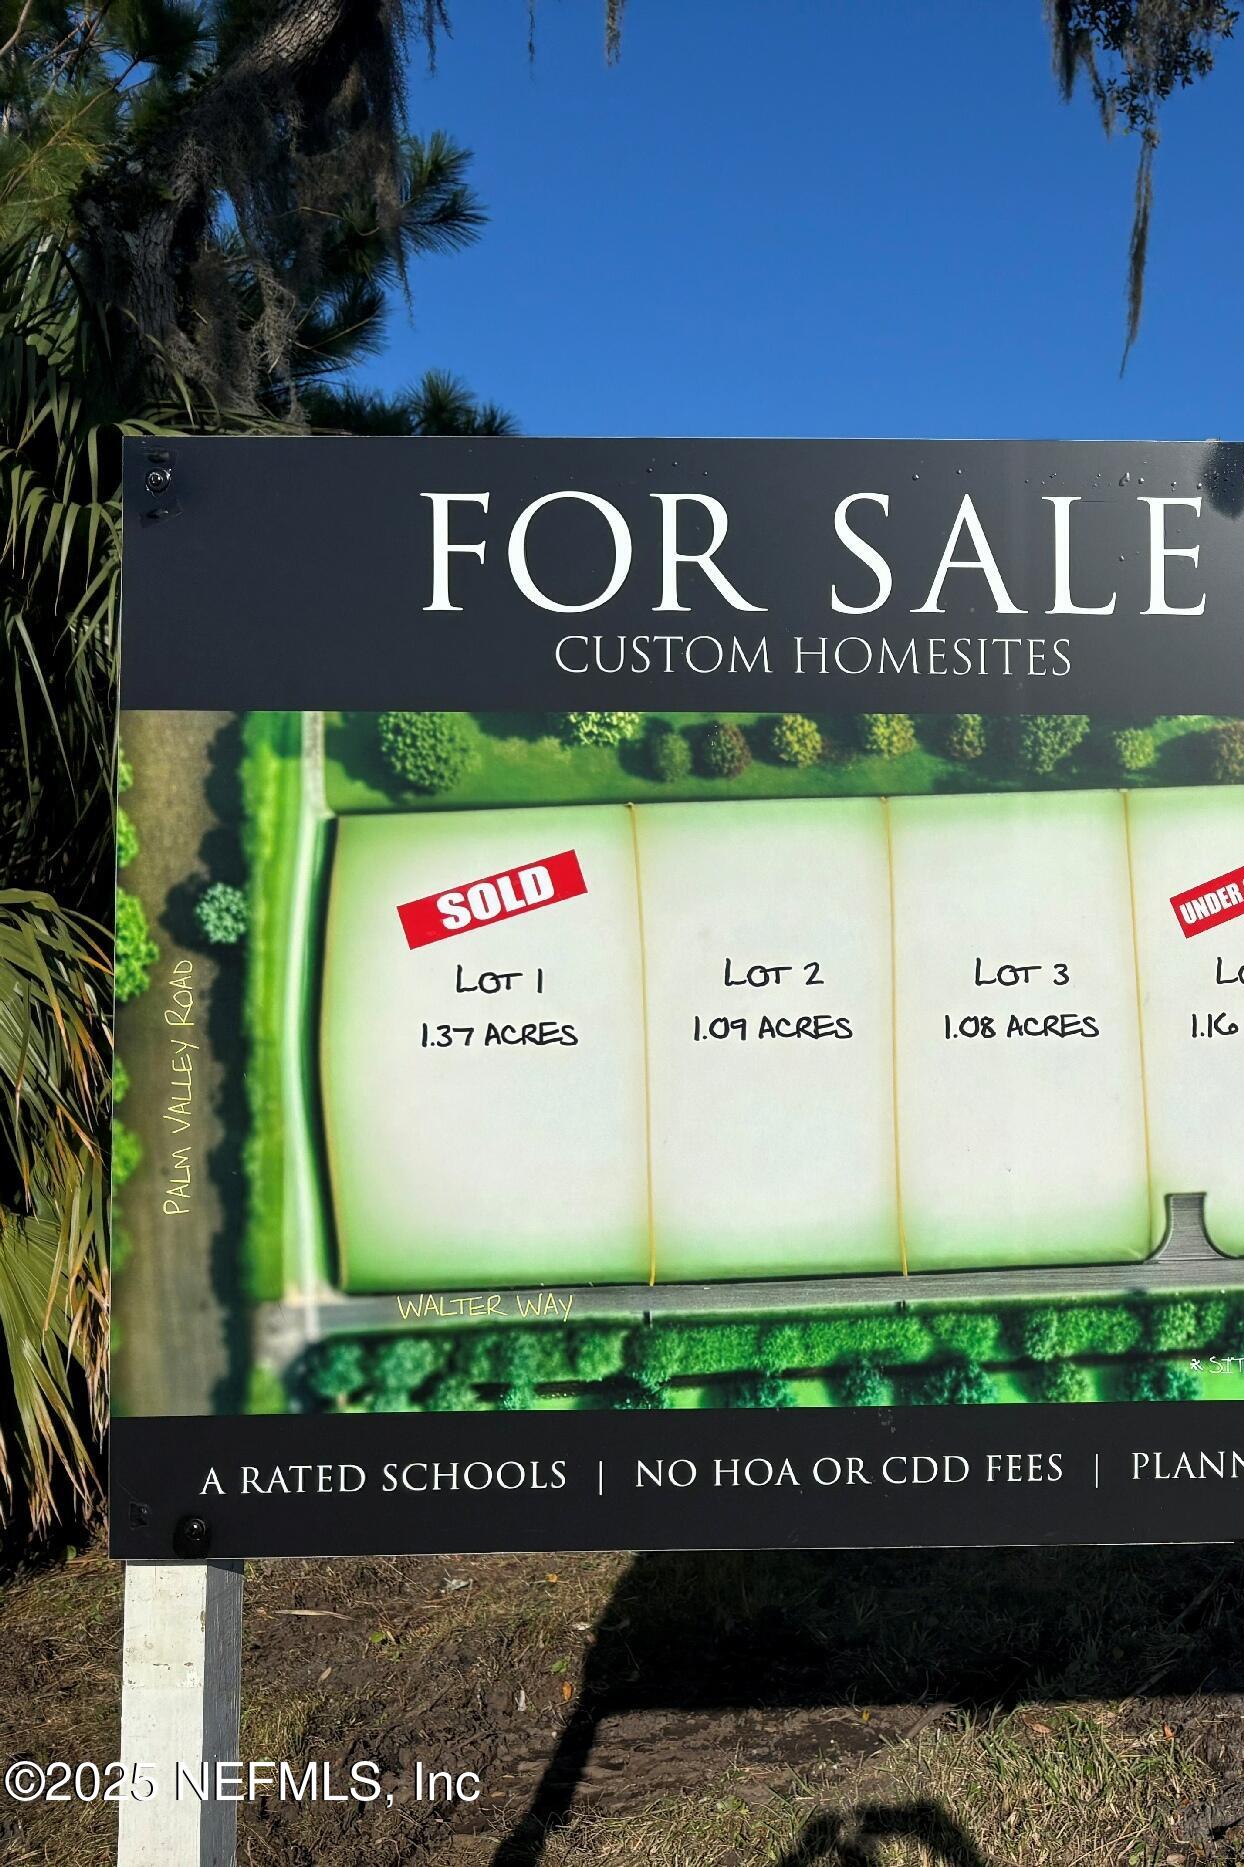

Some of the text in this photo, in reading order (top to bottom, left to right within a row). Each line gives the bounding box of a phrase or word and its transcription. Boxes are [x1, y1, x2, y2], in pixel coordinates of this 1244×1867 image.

[420, 490, 1207, 615] FOR SALE
[554, 635, 1074, 677] CUSTOM HOMESITES
[436, 864, 556, 931] SOLD
[1179, 881, 1244, 925] UNDER
[455, 964, 544, 994] LOT 1
[724, 958, 826, 987] LOT 2
[974, 957, 1070, 987] LOT 3
[421, 1021, 579, 1048] 1.37 ACRES
[694, 1015, 853, 1042] 1.09 ACRES
[944, 1014, 1100, 1039] 1.08 ACRES
[1192, 1013, 1239, 1039] 1.16
[163, 959, 200, 1215] PALM VALLEY ROAD
[397, 1292, 573, 1322] WALTER WAY
[200, 1460, 567, 1495] A RATED SCHOOLS
[635, 1453, 1064, 1489] NO HOA OR CDD FEES
